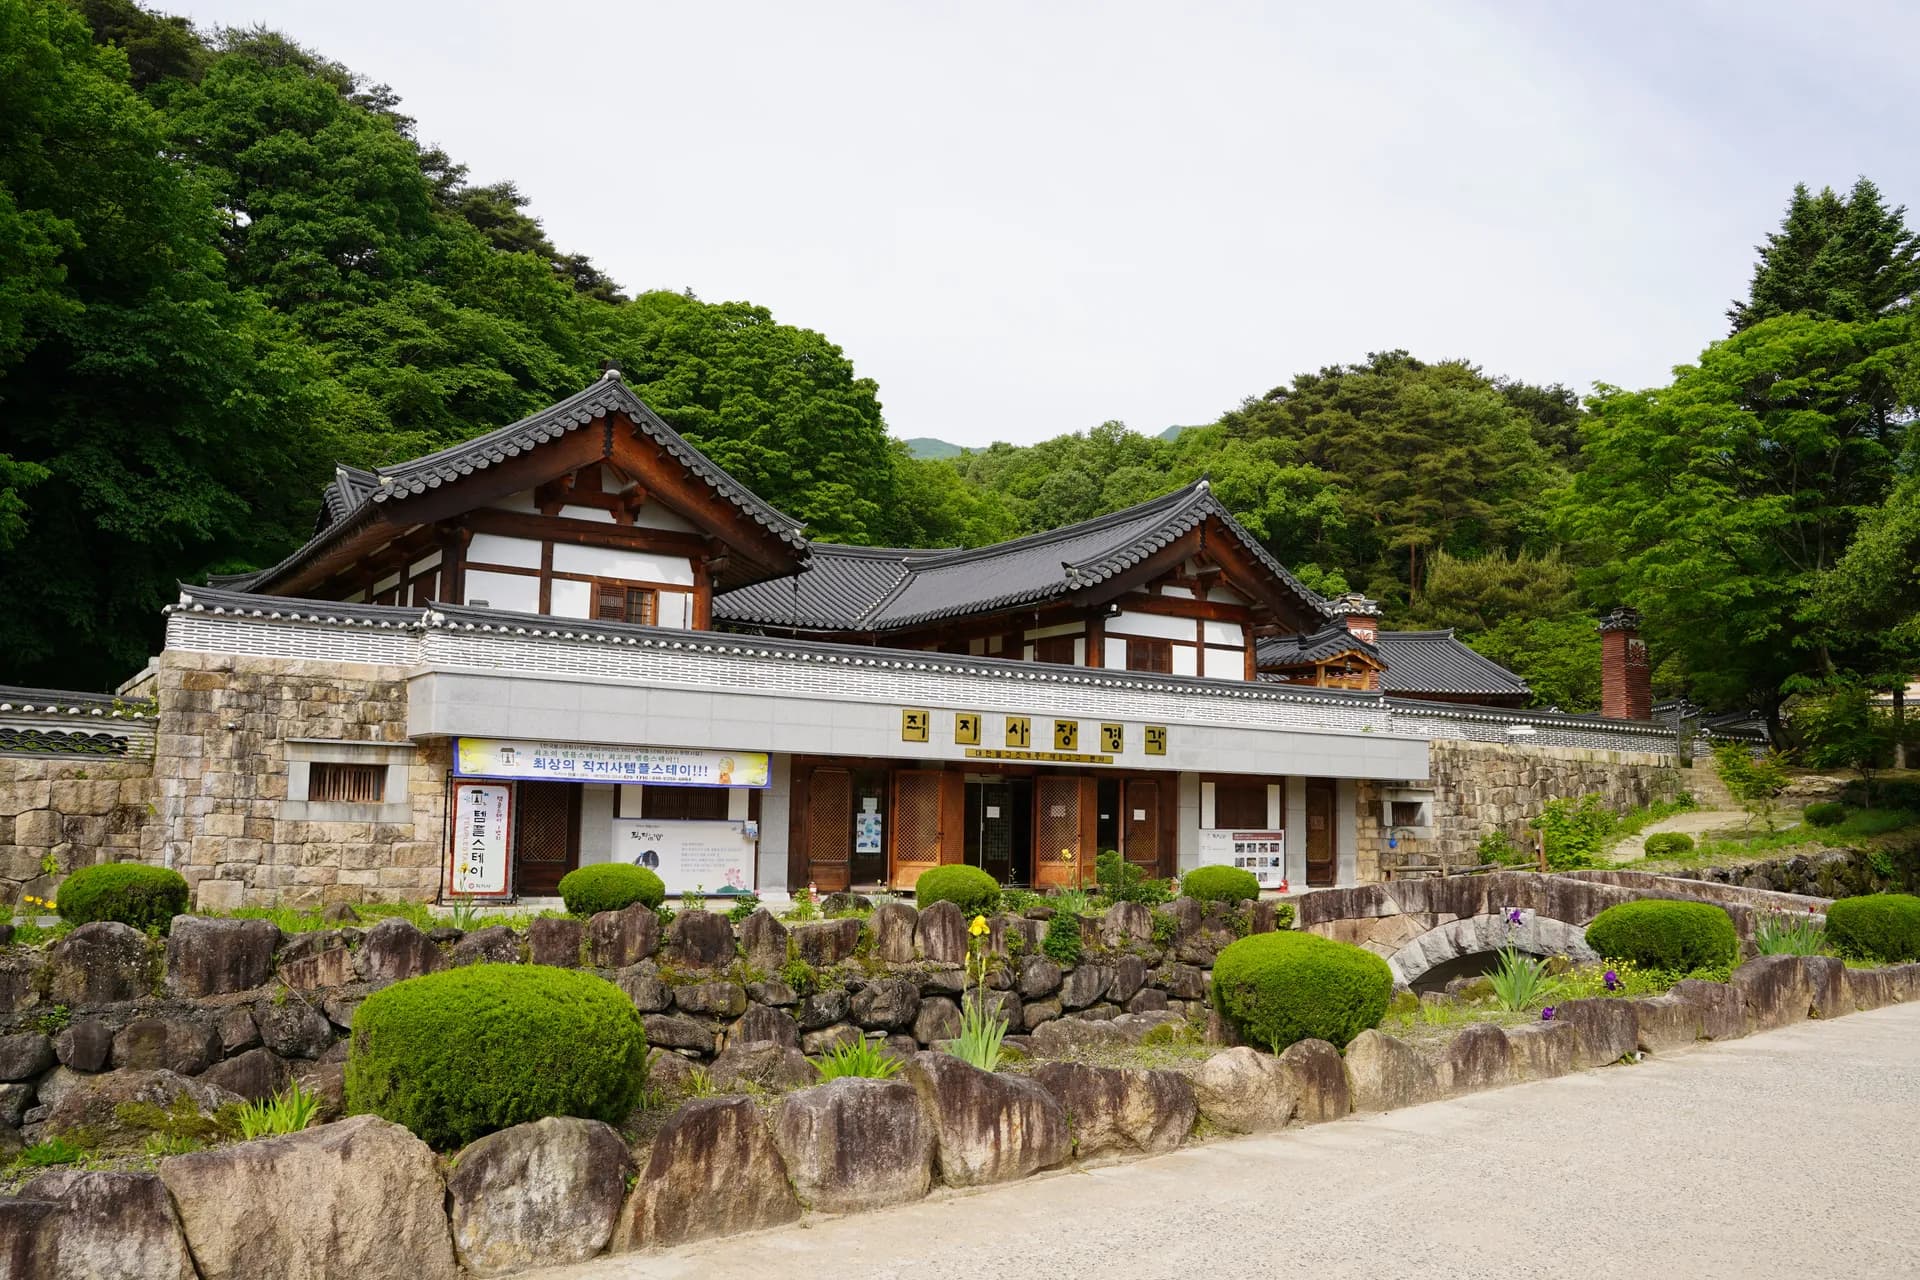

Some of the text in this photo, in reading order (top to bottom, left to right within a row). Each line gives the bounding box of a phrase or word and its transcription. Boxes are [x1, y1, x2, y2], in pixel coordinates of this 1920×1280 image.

[533, 758, 575, 771] 최상의
[582, 760, 709, 777] 직지사템플스테이!!!
[470, 810, 487, 878] 템플스테이
